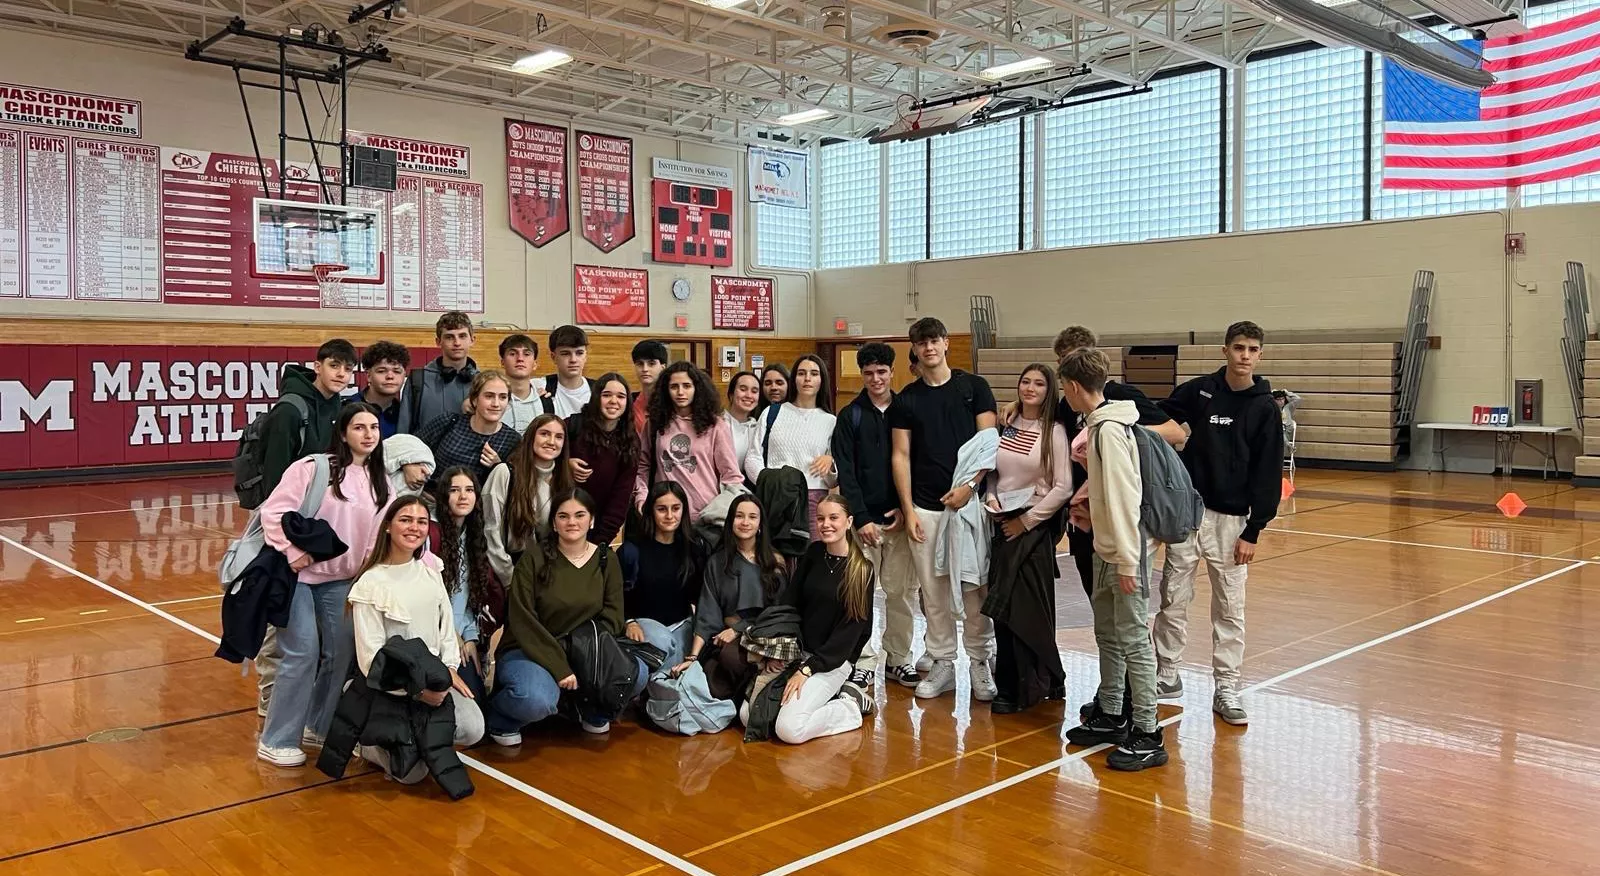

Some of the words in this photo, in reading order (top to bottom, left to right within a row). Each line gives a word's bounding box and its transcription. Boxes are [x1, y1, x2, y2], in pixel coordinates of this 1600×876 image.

[5, 101, 123, 125] CHIEFTAINS
[5, 113, 43, 123] TRACK
[57, 118, 84, 128] FIELD
[88, 124, 136, 135] RECORDS
[525, 127, 565, 145] MASCONOMET
[29, 136, 65, 153] EVENTS
[77, 141, 107, 151] GIRLS
[109, 146, 156, 156] RECORDS
[367, 136, 466, 159] MASCONOMET
[545, 145, 563, 155] TRACK
[594, 139, 630, 155] MASCONOMET
[89, 150, 106, 158] NAME
[398, 151, 458, 168] IEFTAINS
[510, 150, 563, 164] CHAMPIONSHIPS
[223, 159, 266, 169] MASCONOMT
[415, 163, 434, 172] FIELD
[435, 166, 468, 176] RECORDS
[580, 160, 630, 173] CHAMPIONSHIPS
[658, 160, 694, 173] INSTITUTION
[695, 167, 706, 175] FOR
[707, 167, 728, 178] SAVINGS
[325, 168, 342, 178] BOY
[220, 176, 237, 184] CROSS
[239, 178, 263, 187] COUNTRY
[397, 177, 418, 192] VENTS
[426, 180, 447, 189] GIRLS
[448, 183, 480, 192] RECORDS
[659, 223, 678, 233] HOME
[709, 229, 731, 239] VISITOR
[661, 233, 675, 241] FOULS
[579, 268, 645, 280] MASCONOMET
[578, 285, 596, 293] 1000
[715, 279, 769, 288] MASCONOMET
[0, 380, 75, 433] M
